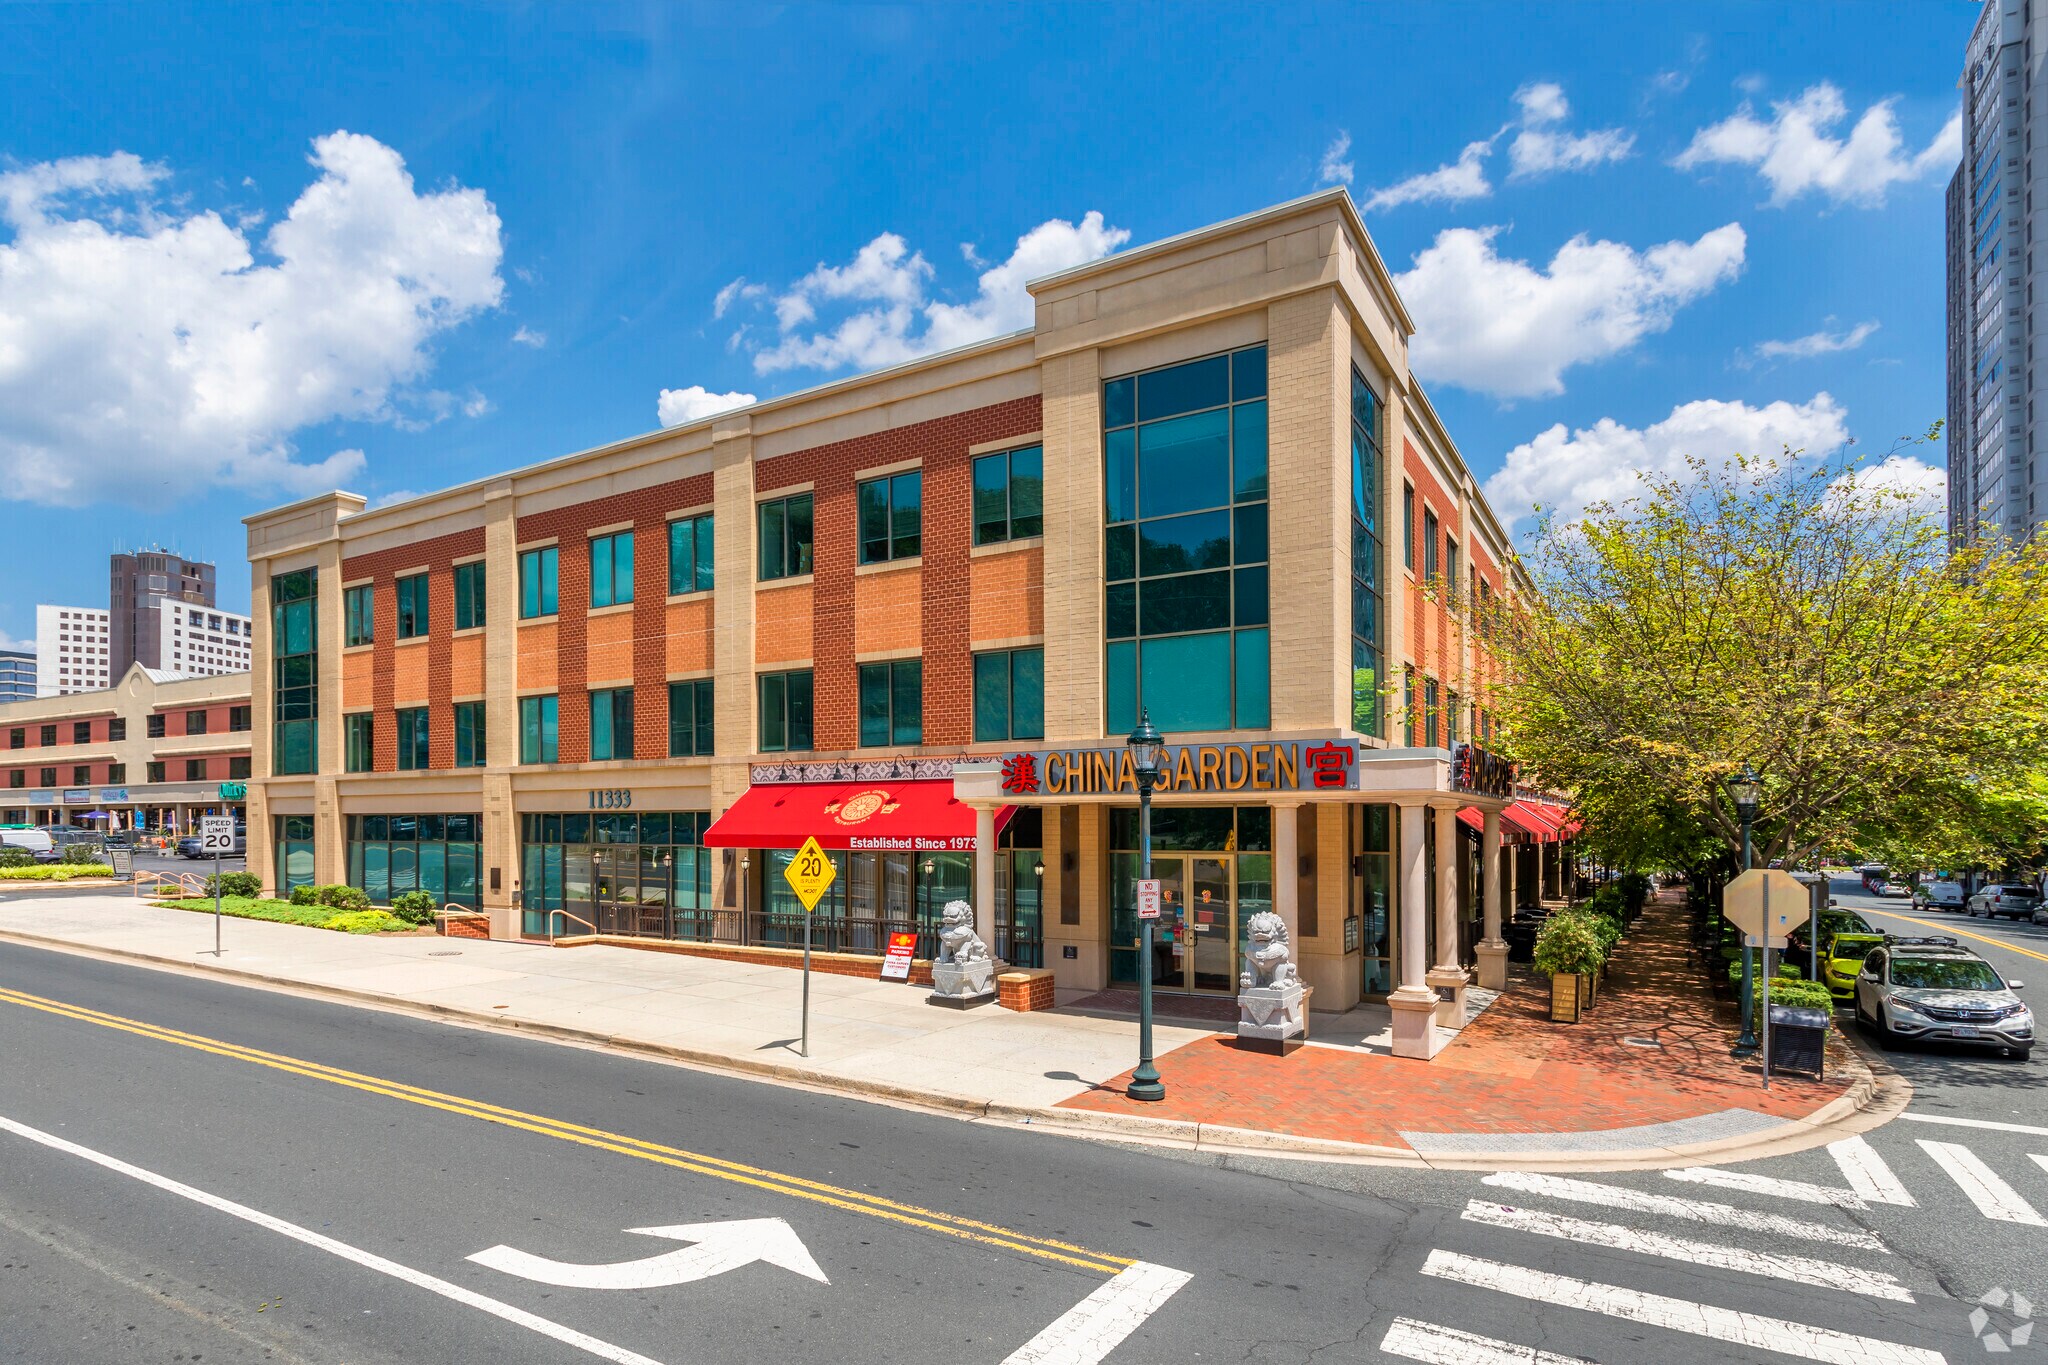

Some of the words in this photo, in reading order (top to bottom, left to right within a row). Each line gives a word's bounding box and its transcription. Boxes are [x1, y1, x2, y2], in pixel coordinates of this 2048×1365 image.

[1001, 752, 1040, 793] 漢
[1044, 748, 1139, 793] CHINA
[1149, 743, 1298, 792] GARDEN
[1306, 741, 1354, 788] 宮
[588, 789, 632, 809] 11333
[848, 790, 870, 801] CHINA
[205, 834, 231, 847] 20
[850, 837, 912, 849] Established
[915, 838, 946, 849] Since
[950, 837, 977, 849] 1973
[801, 857, 821, 877] 20
